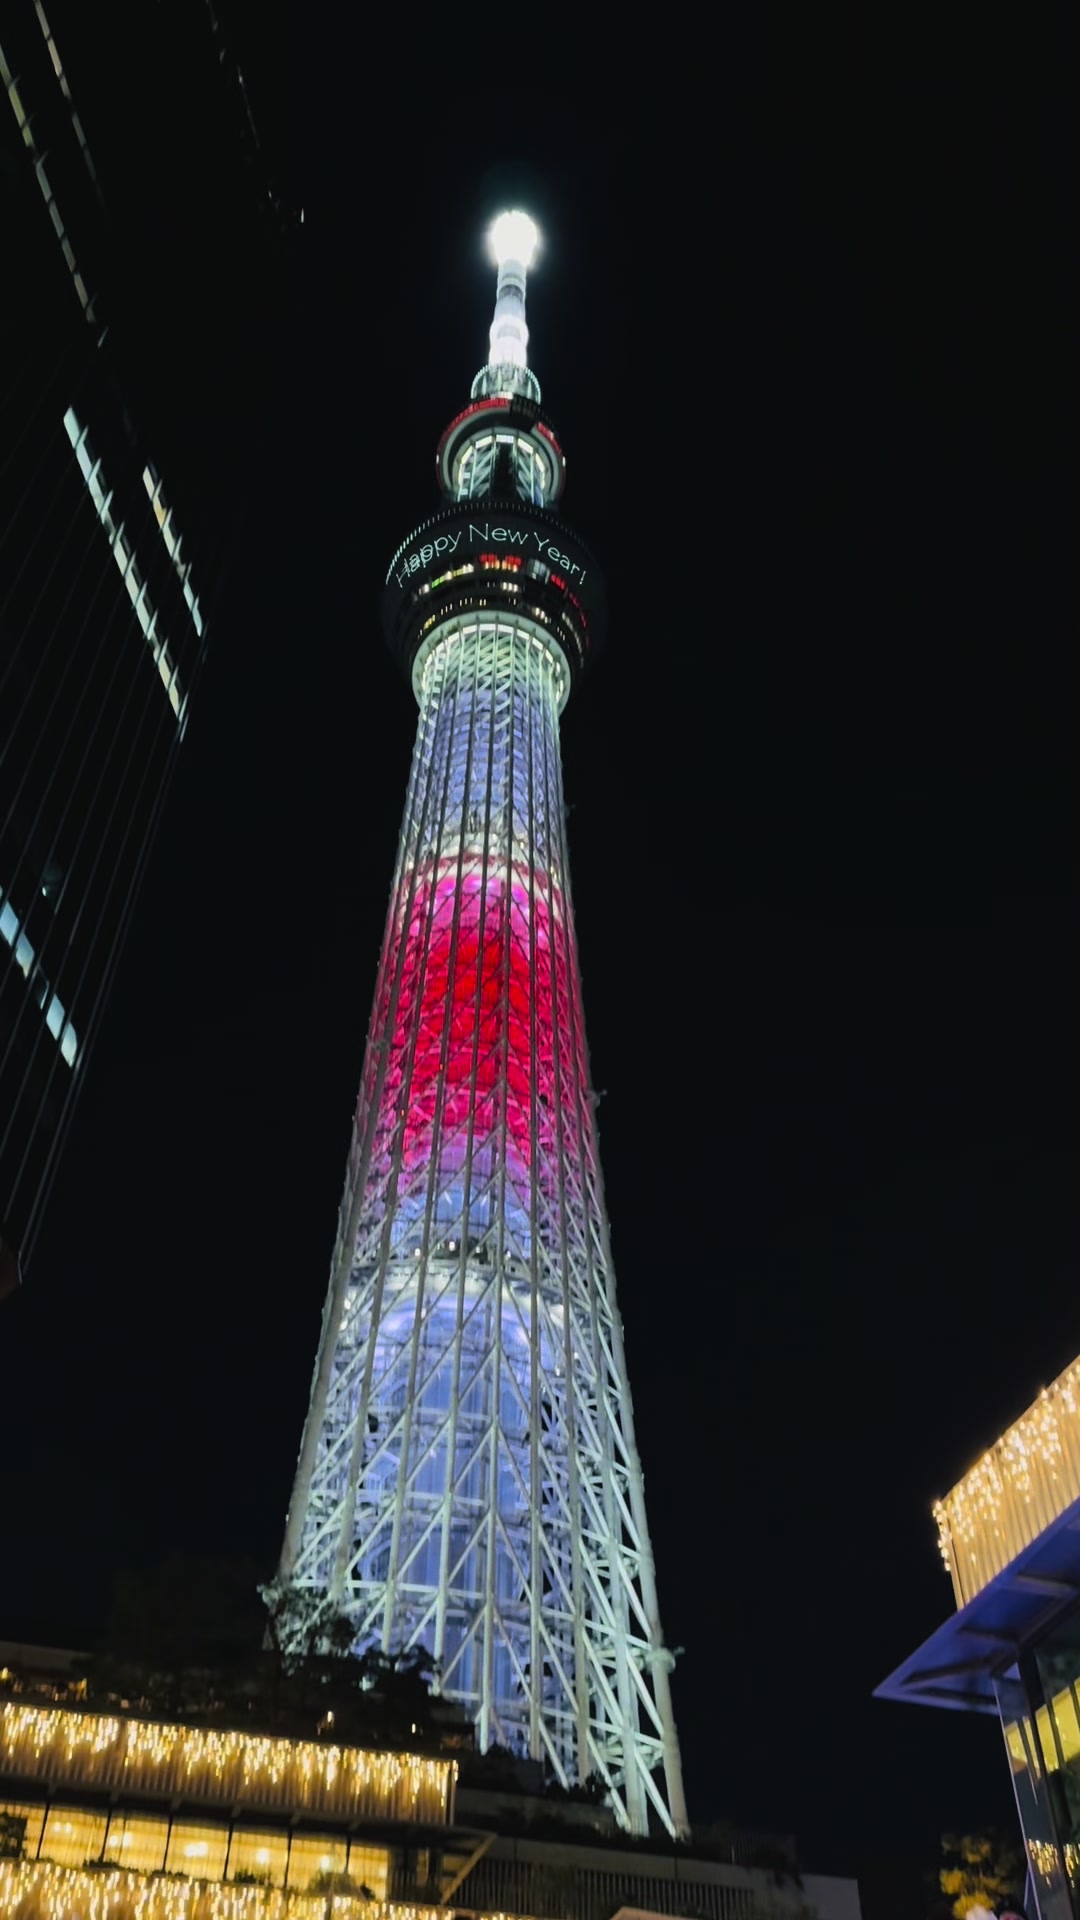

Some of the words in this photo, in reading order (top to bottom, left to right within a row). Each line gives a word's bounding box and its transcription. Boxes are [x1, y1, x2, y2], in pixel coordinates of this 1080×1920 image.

[396, 531, 462, 588] Happy
[469, 523, 528, 545] New
[533, 531, 586, 585] Year!
